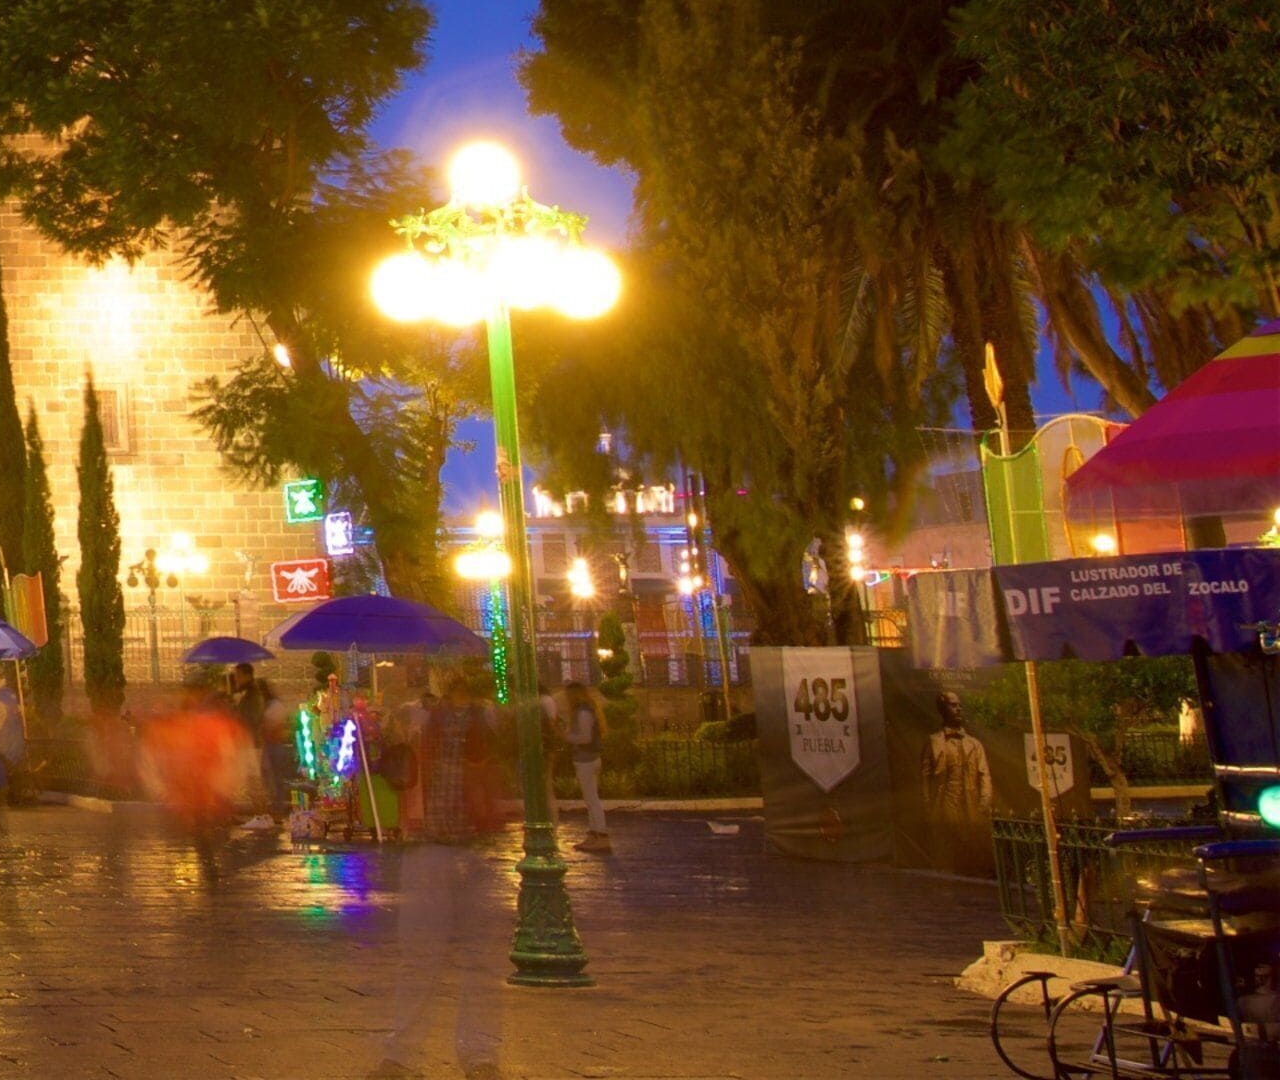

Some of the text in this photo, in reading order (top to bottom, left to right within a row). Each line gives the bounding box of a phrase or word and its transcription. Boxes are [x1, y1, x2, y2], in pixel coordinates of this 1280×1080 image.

[1070, 562, 1182, 583] LUSTRADOR DE
[1004, 587, 1061, 615] DIF
[1070, 580, 1249, 601] CALZADO DEL ZOCALO
[794, 677, 849, 721] 485
[803, 738, 846, 753] PUEBLA
